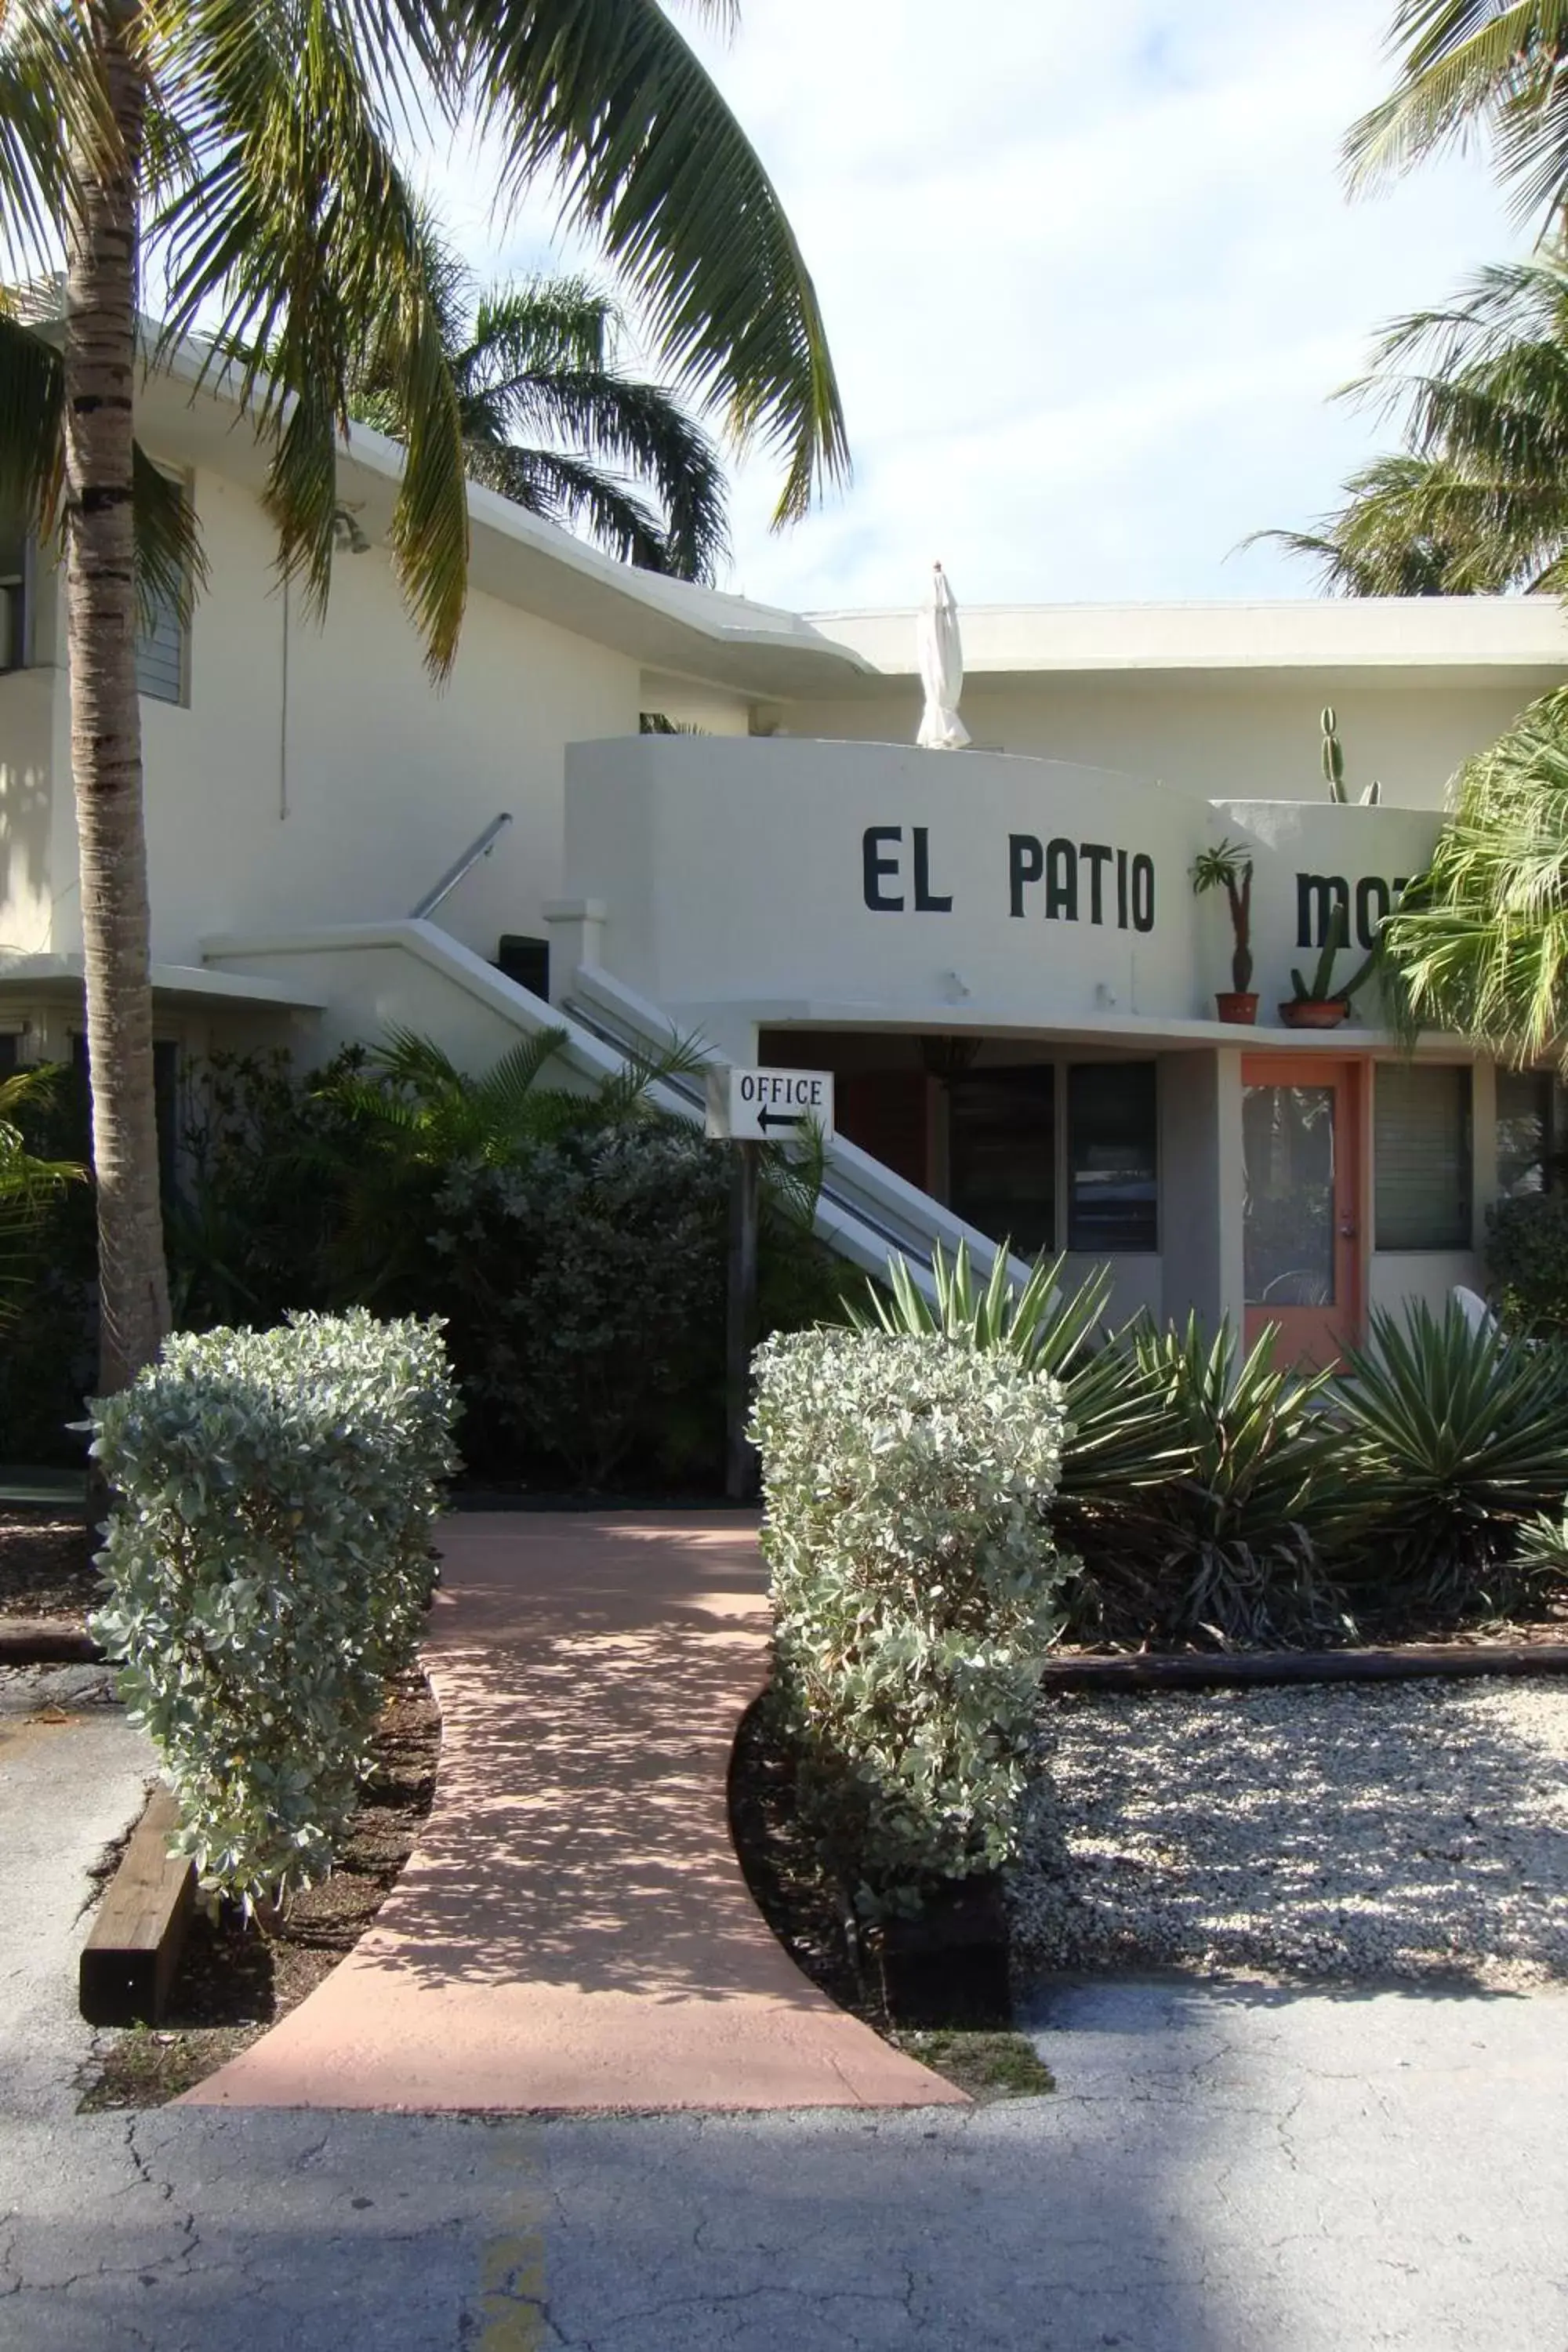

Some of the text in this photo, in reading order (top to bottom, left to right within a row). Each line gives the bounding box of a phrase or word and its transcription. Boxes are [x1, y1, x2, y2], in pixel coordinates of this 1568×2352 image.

[862, 826, 952, 912] EL
[1009, 833, 1155, 933] PATIO
[741, 1076, 822, 1105] OFFICE
